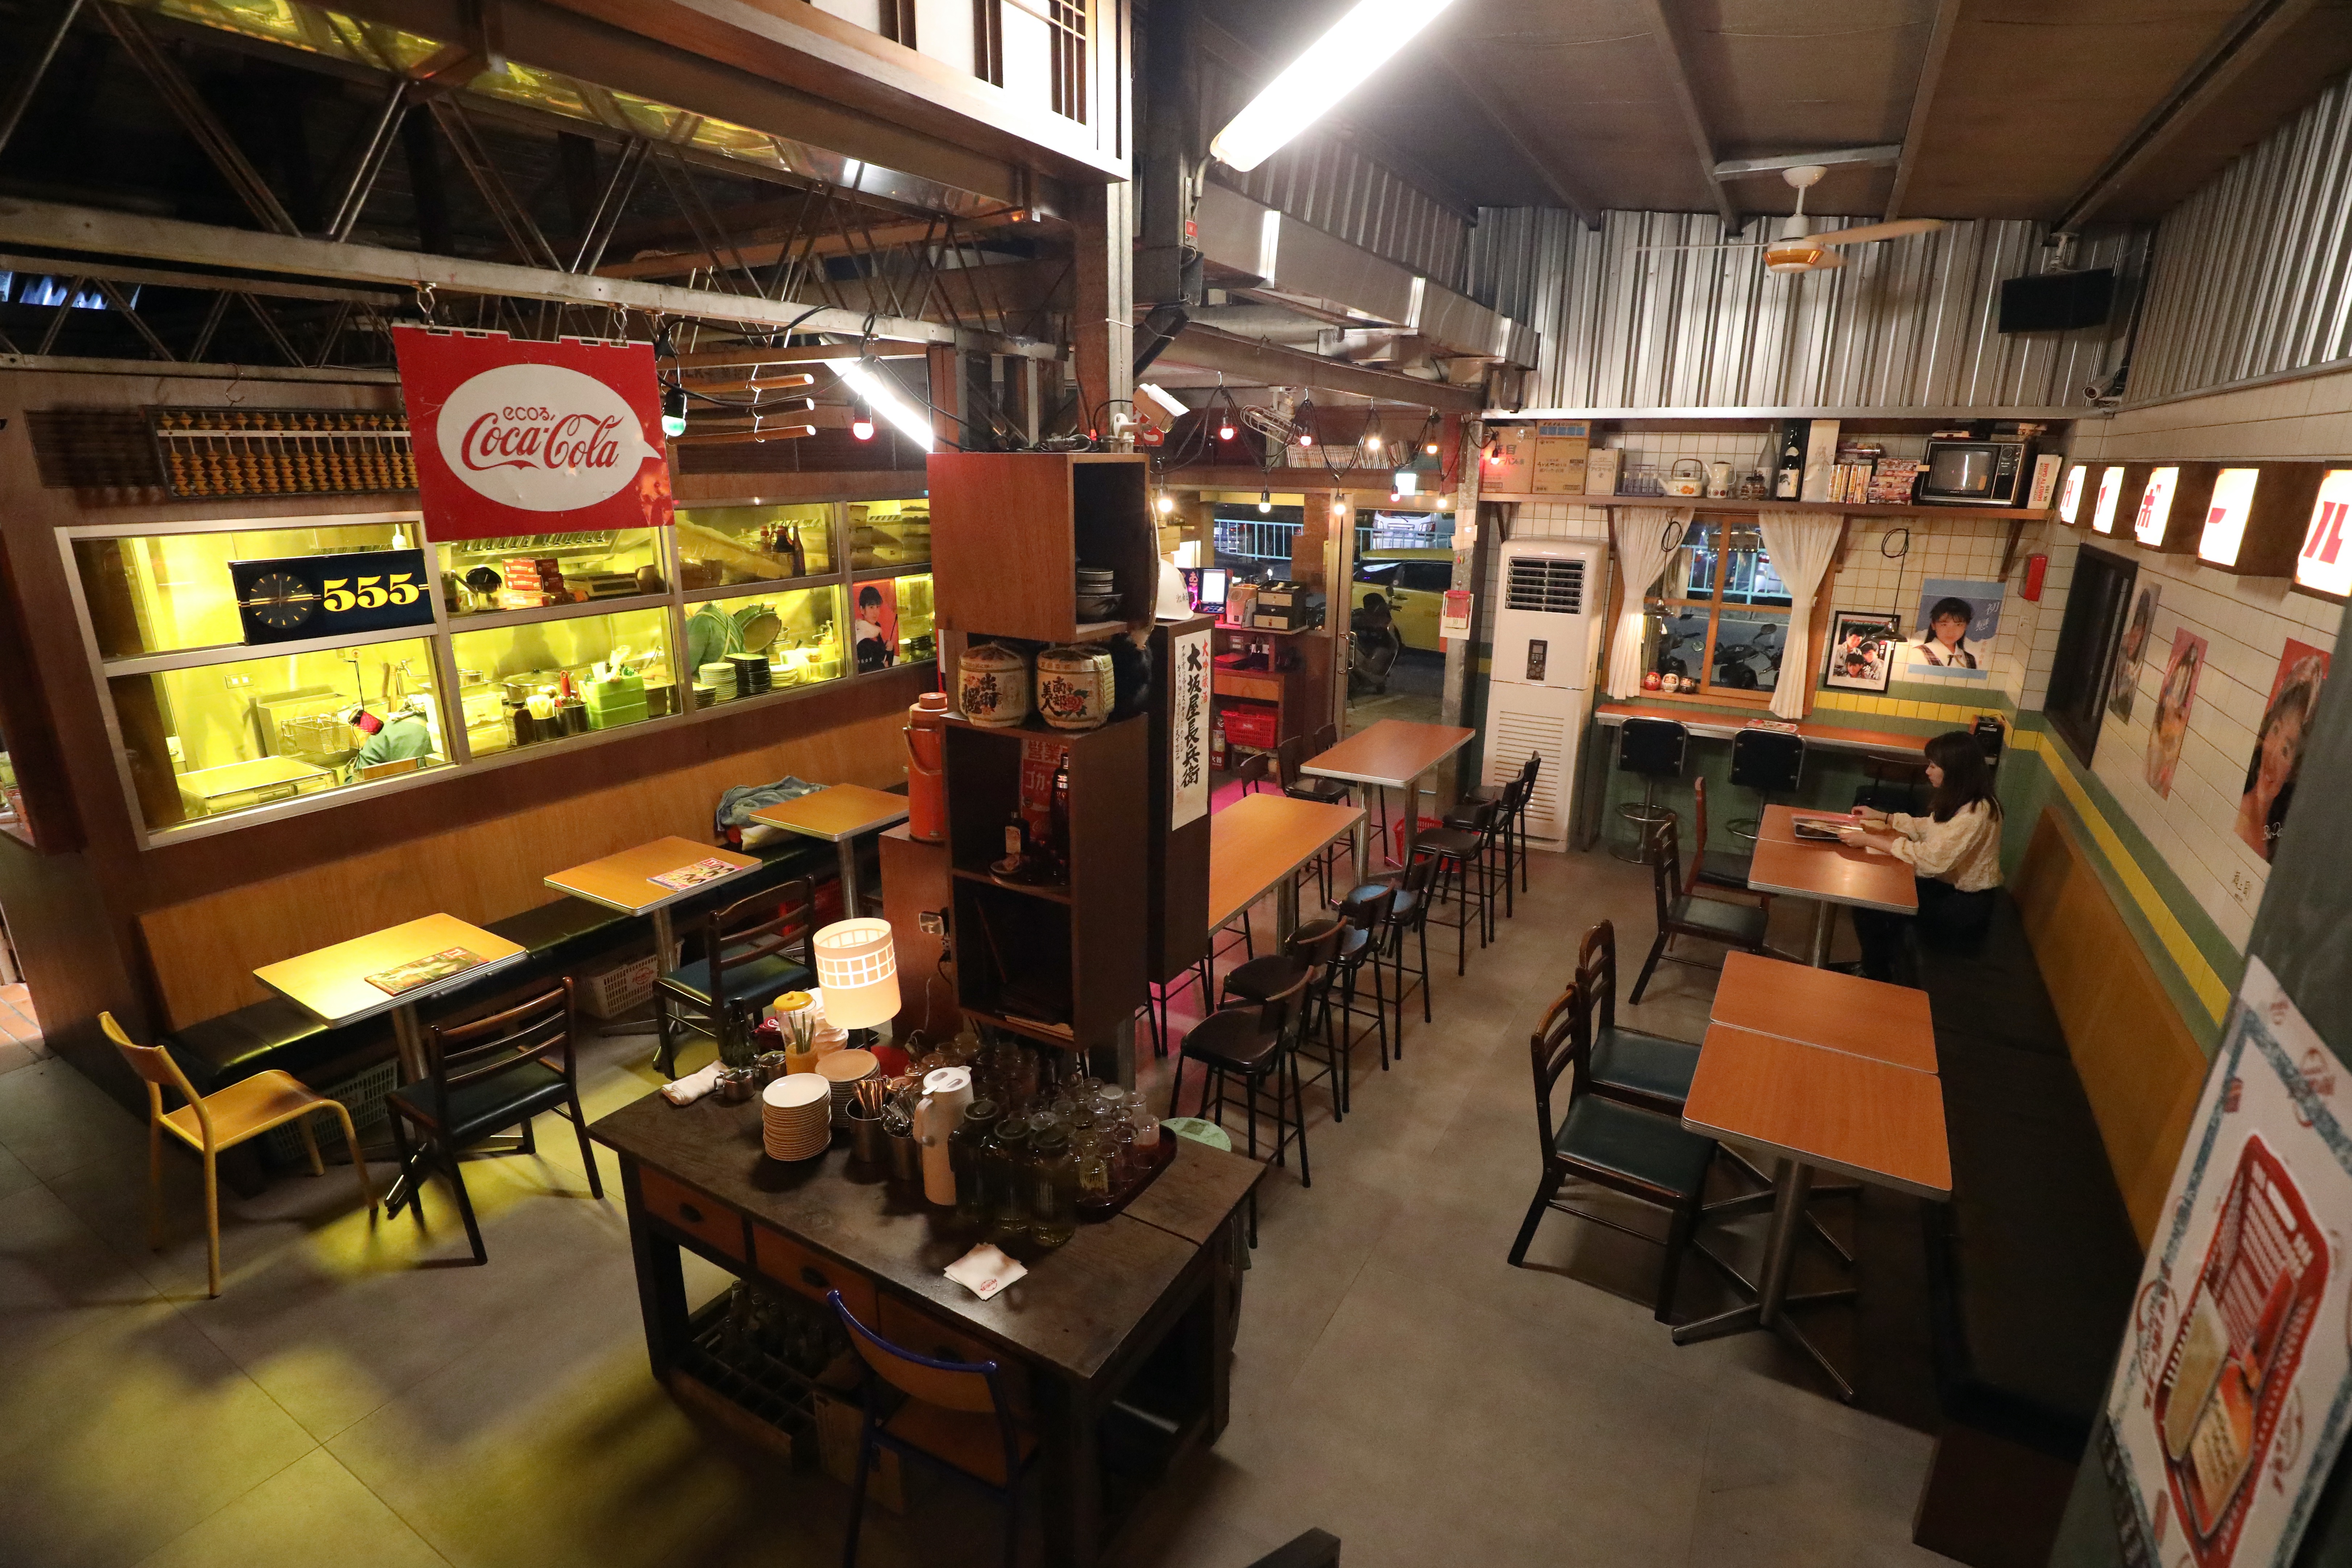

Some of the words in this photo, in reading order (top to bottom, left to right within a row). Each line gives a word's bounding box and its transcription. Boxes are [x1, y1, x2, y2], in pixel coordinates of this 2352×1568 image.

[461, 412, 624, 470] Coca-Cola
[323, 573, 420, 612] 555
[1041, 681, 1062, 717] 美人
[1052, 675, 1067, 706] 南部
[1180, 643, 1202, 788] 大坂屋長兵衛
[448, 948, 467, 957] TV
